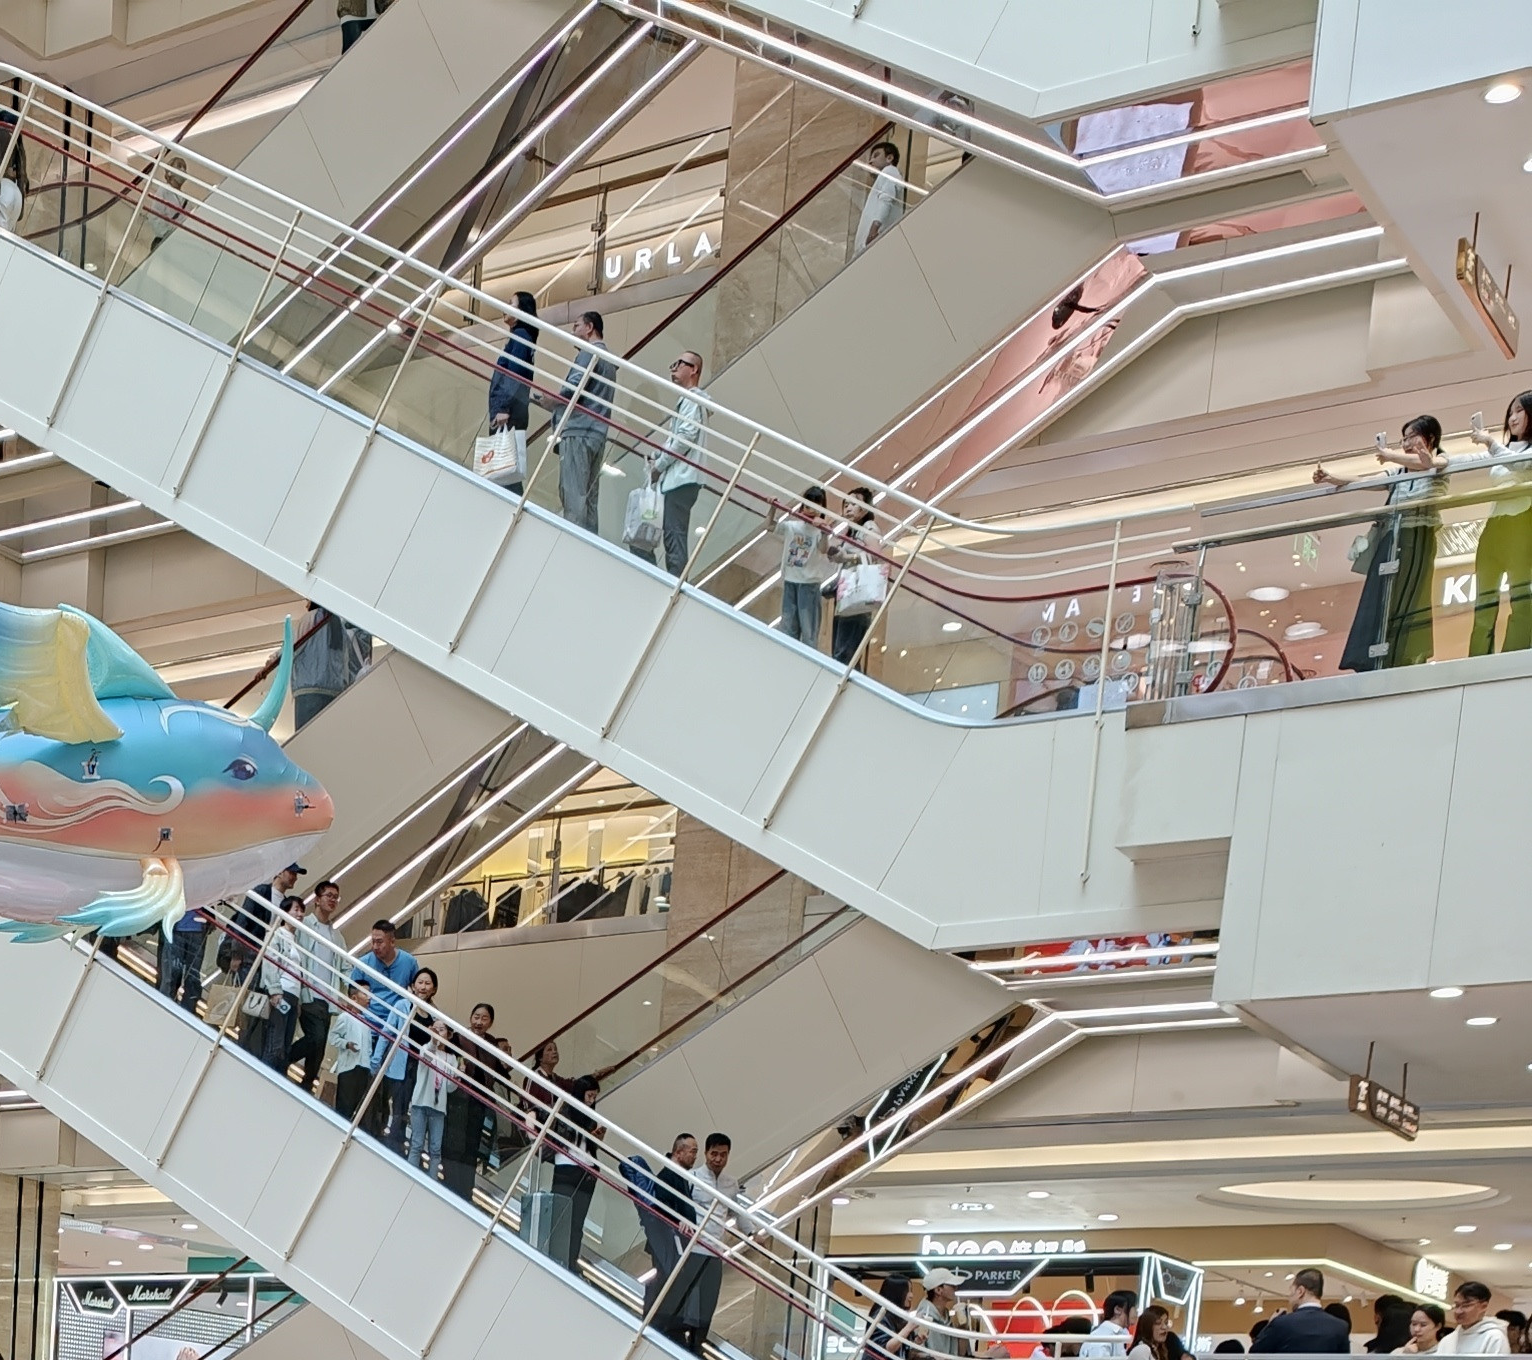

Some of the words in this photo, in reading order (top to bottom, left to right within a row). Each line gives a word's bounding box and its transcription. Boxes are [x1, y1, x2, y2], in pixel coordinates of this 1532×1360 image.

[975, 1270, 1021, 1280] PARKER
[81, 1291, 114, 1310] Marshall
[127, 1285, 173, 1301] Marshall
